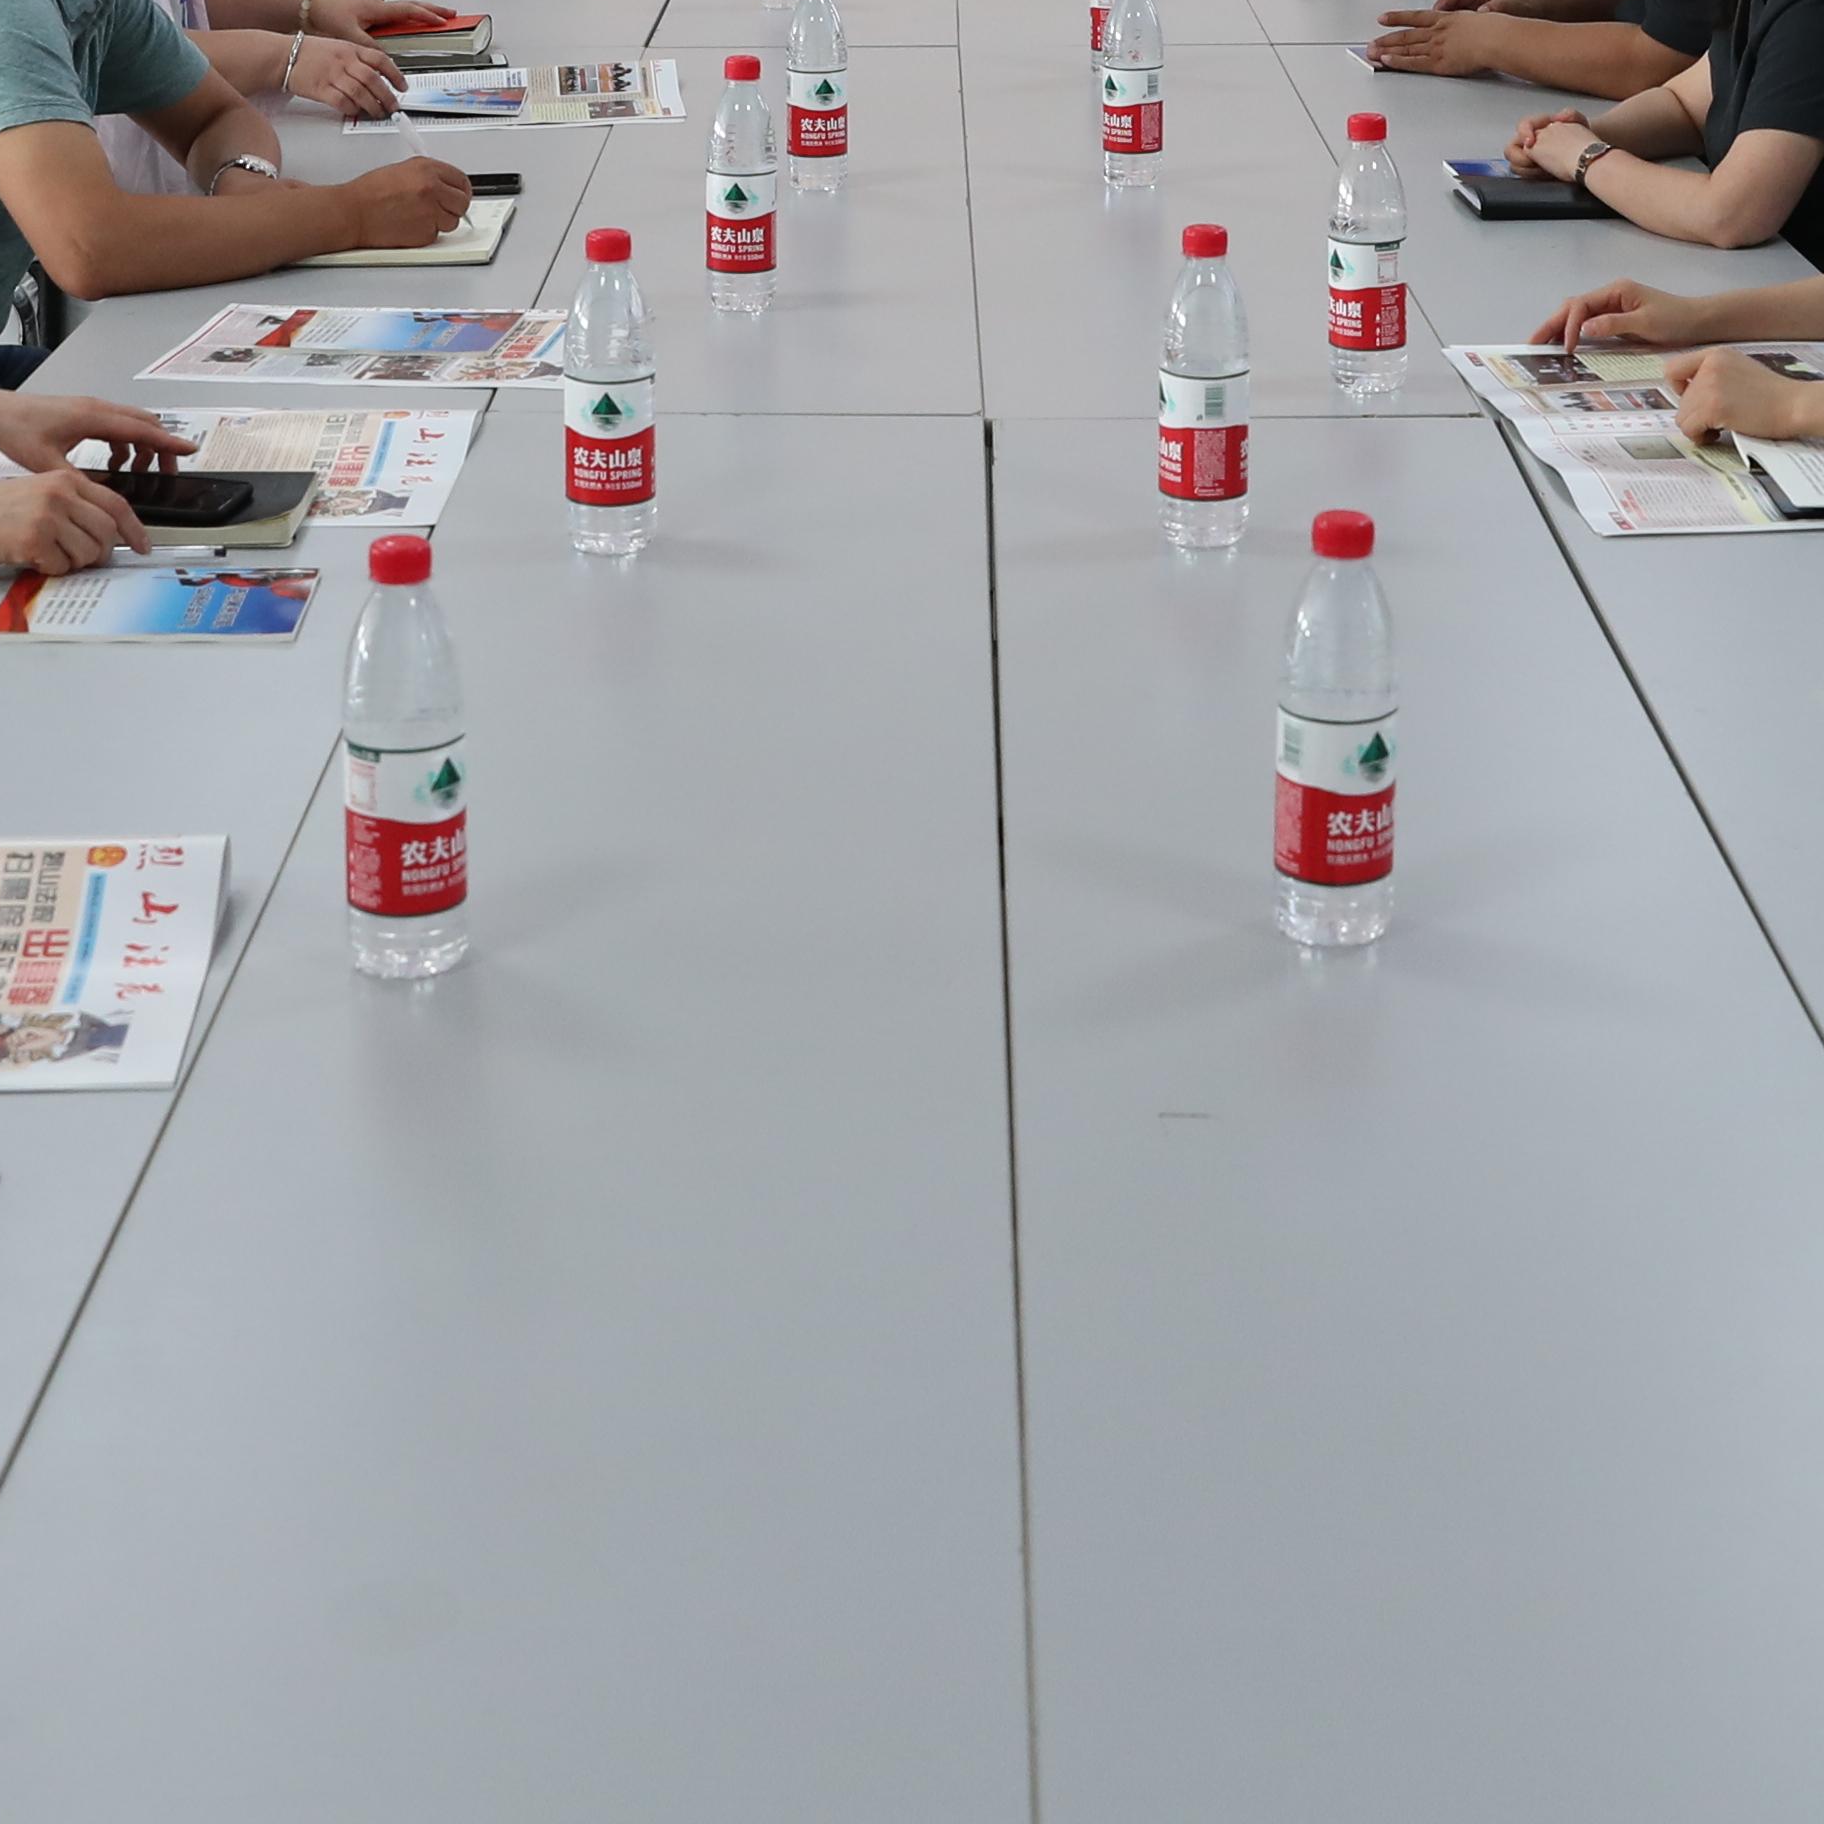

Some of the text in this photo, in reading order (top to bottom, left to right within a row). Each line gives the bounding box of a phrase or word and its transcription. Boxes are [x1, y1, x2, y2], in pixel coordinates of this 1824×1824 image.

[711, 226, 764, 243] 农夫山泉
[738, 243, 764, 253] SPRING
[574, 447, 643, 468] 农夫山泉
[574, 467, 642, 480] NONGFU SPRING
[1327, 835, 1374, 852] NONGFU
